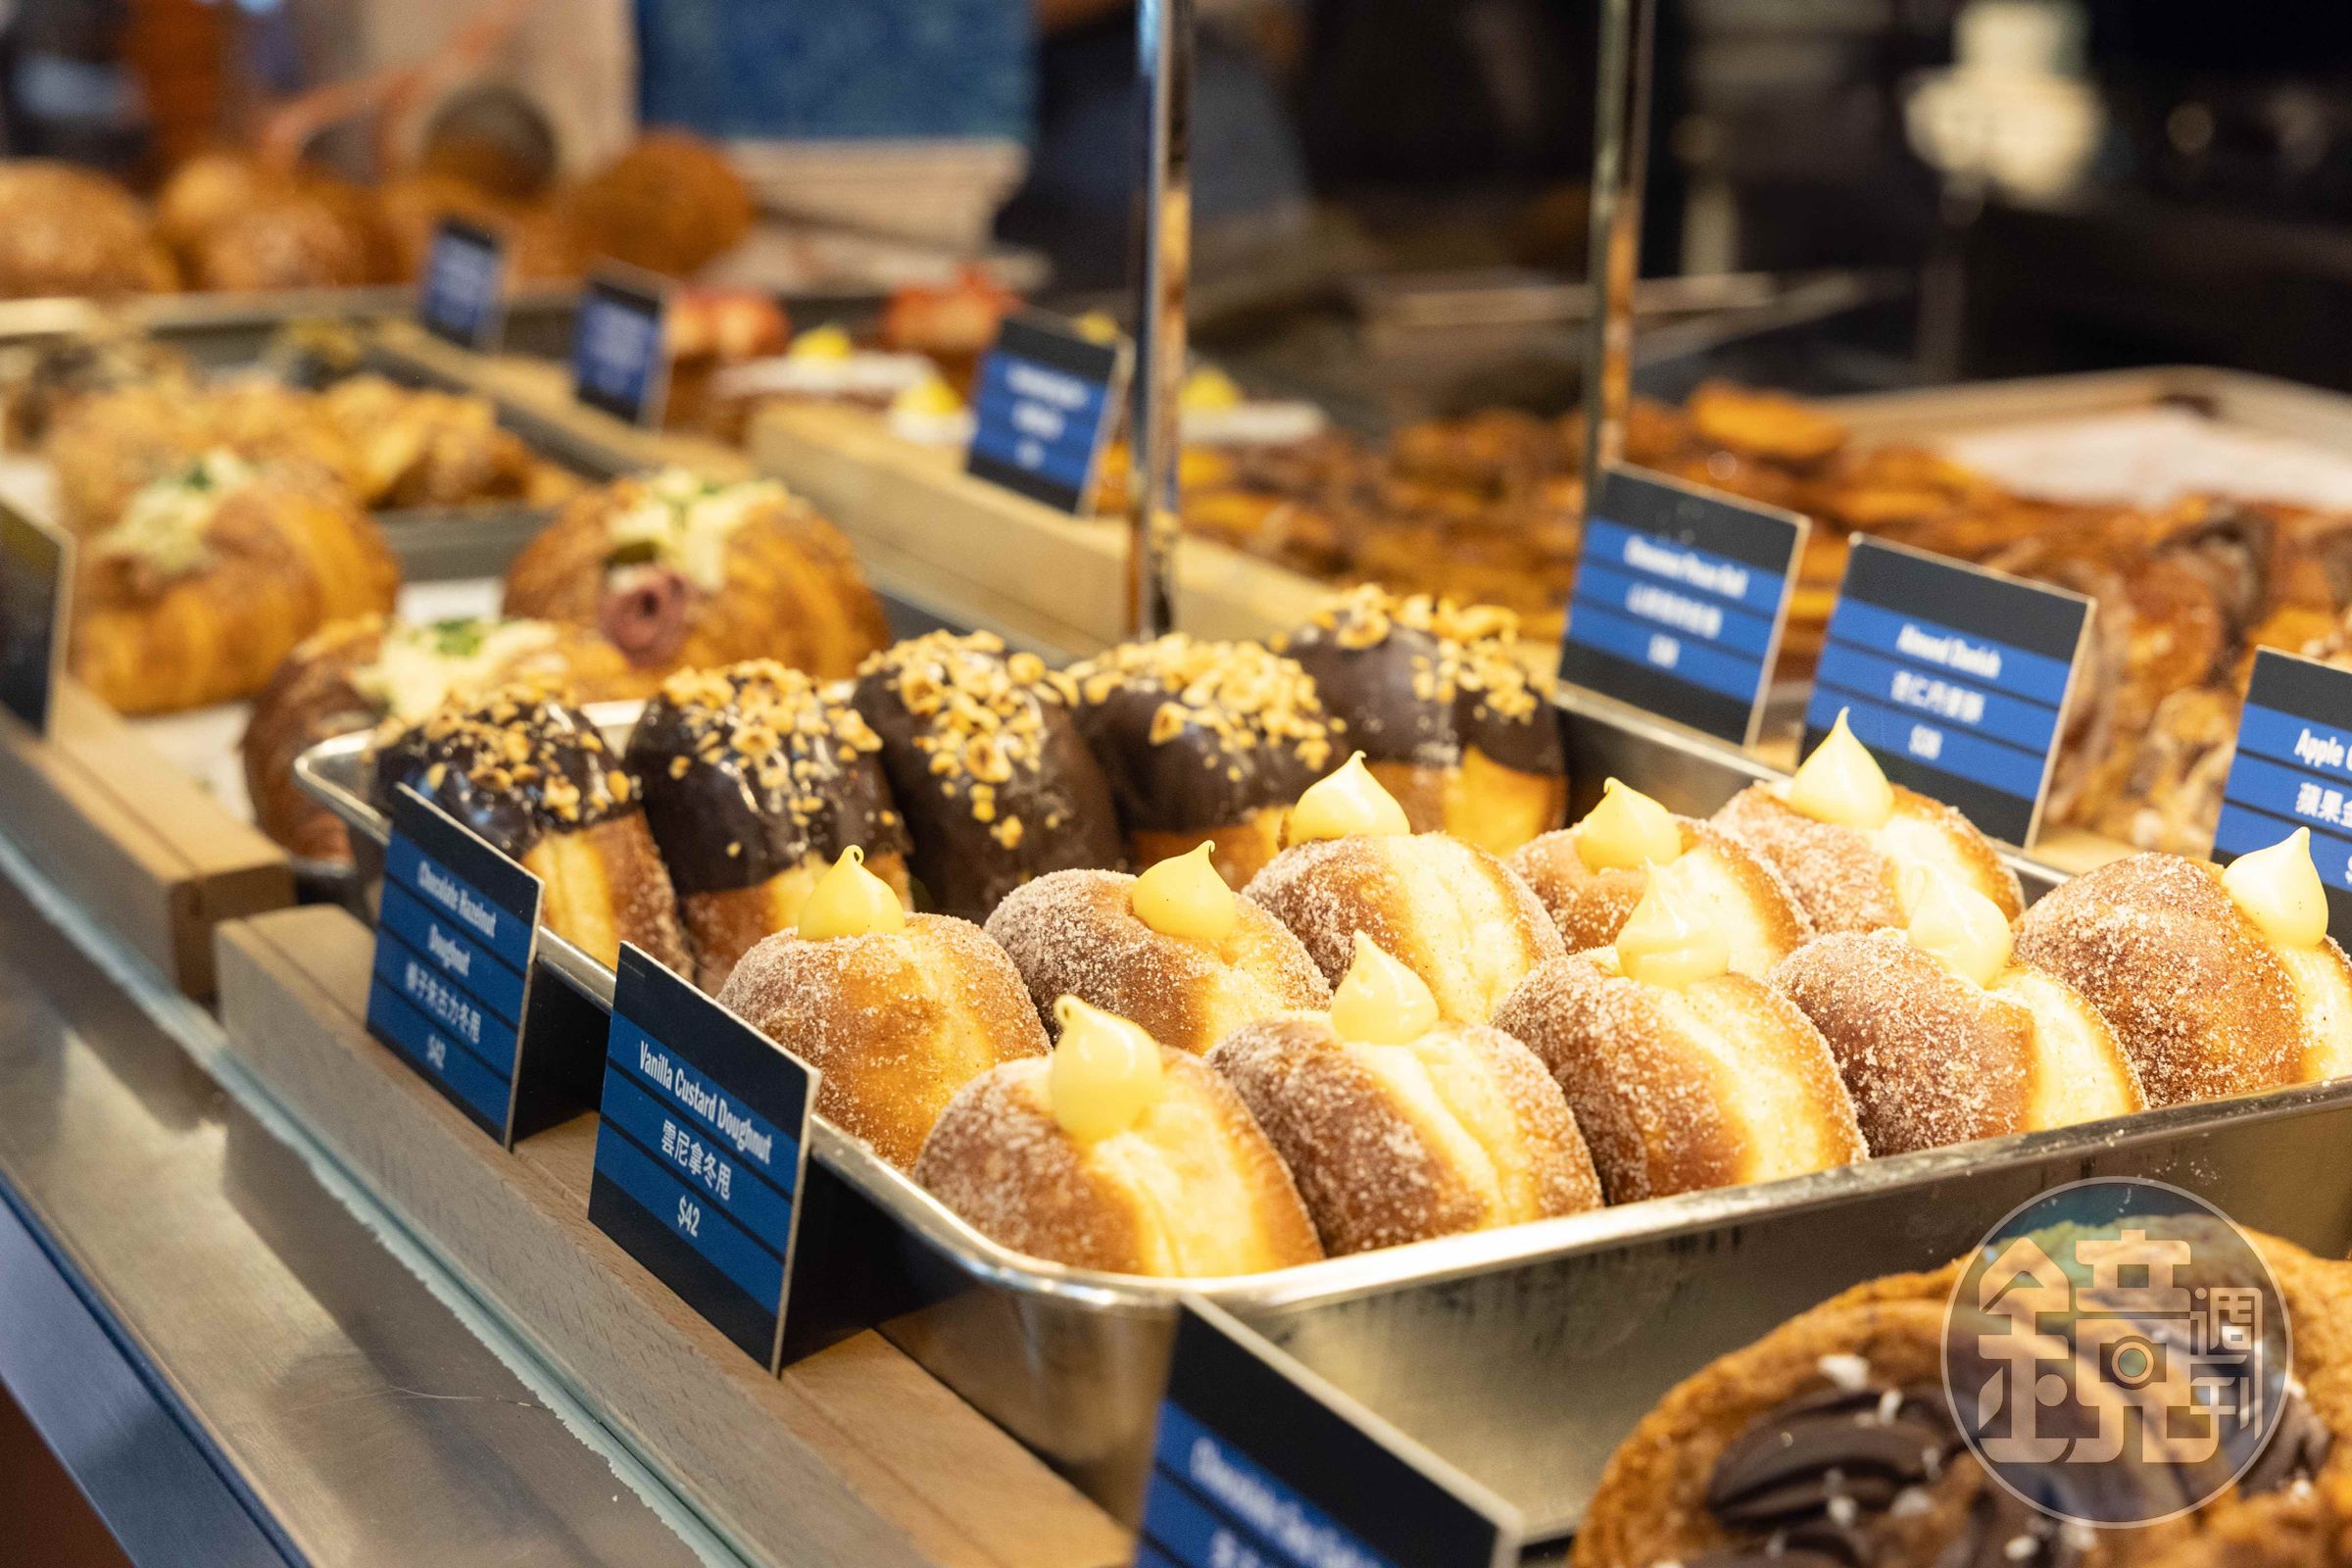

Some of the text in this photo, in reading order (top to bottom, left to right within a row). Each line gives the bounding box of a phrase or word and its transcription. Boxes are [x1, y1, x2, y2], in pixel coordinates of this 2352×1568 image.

[2294, 728, 2344, 767] Apple
[428, 923, 470, 976] Doughnut
[640, 1041, 772, 1164] Vanilla Custard Doughnut
[662, 1119, 731, 1200] 雲尼拿冬甩
[677, 1195, 700, 1238] $42
